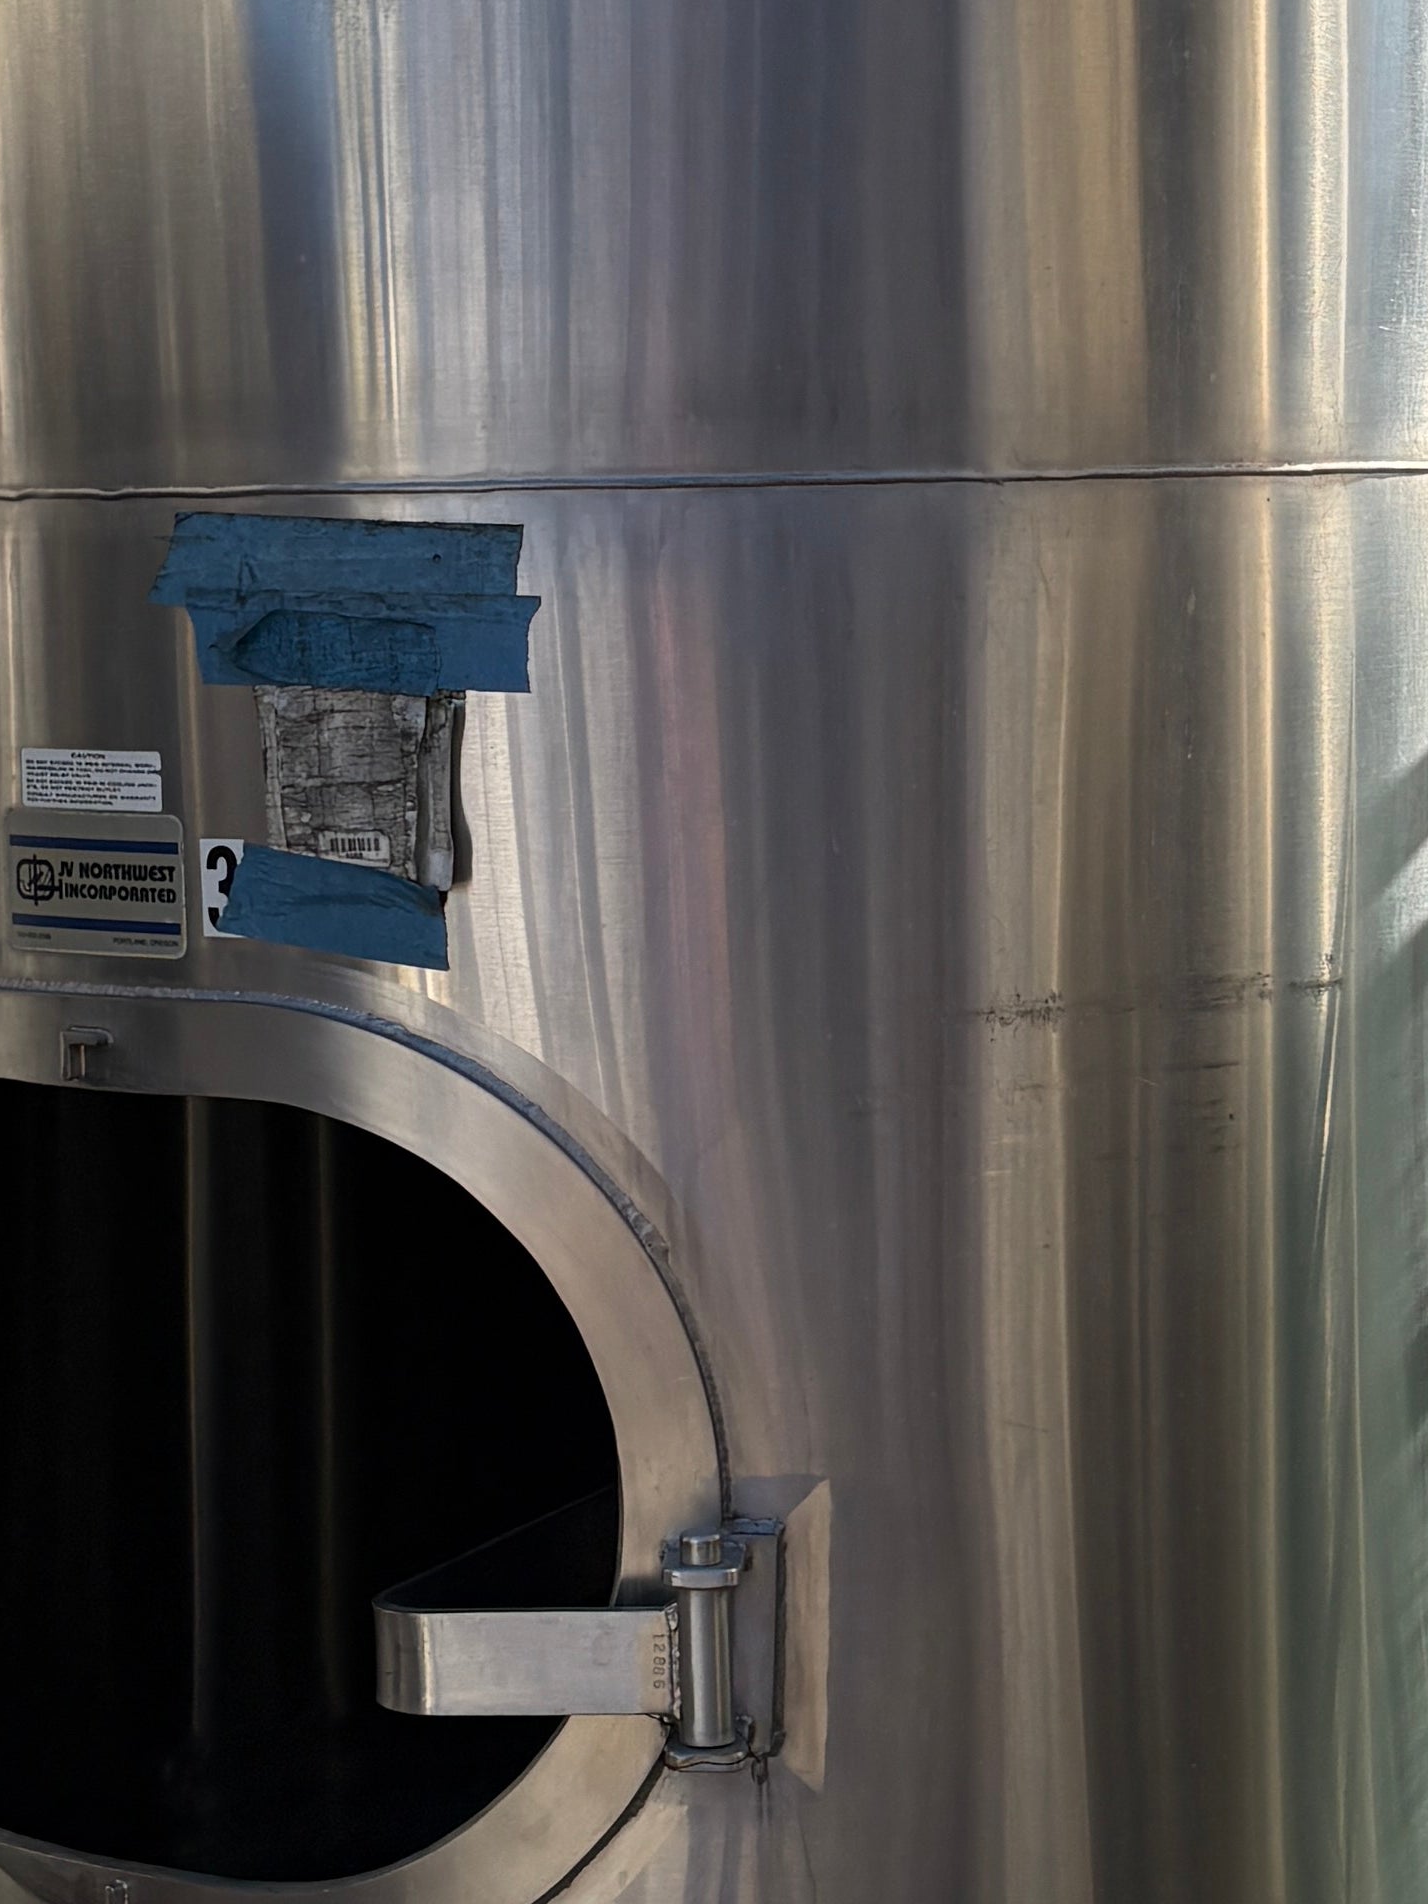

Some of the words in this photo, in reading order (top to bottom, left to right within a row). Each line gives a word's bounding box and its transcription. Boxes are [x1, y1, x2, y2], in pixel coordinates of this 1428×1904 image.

[58, 861, 74, 877] JV
[79, 862, 176, 883] NORTHWEST
[64, 882, 177, 904] INCORPORATED
